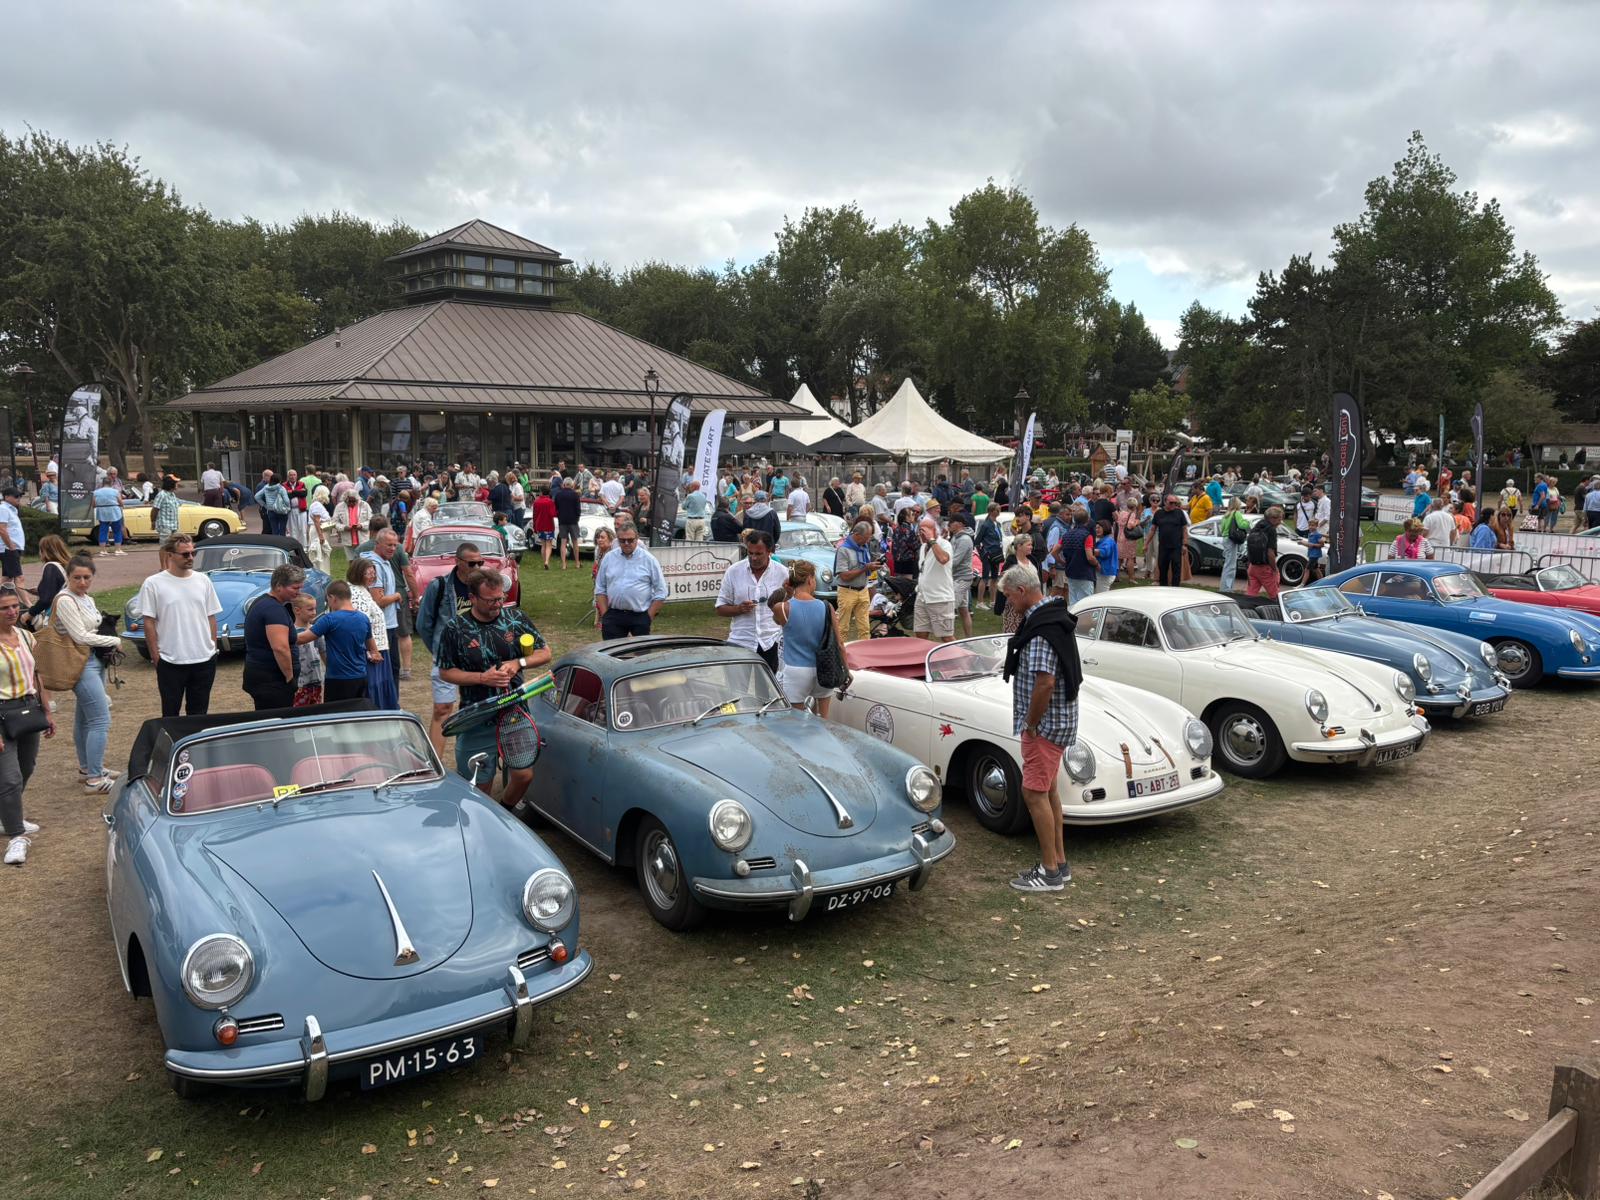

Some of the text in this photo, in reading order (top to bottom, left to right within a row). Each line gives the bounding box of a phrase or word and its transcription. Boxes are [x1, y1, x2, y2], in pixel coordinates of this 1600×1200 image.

[702, 457, 711, 486] STATE
[707, 426, 715, 448] ART
[675, 581, 691, 593] tot
[695, 579, 722, 592] 1965
